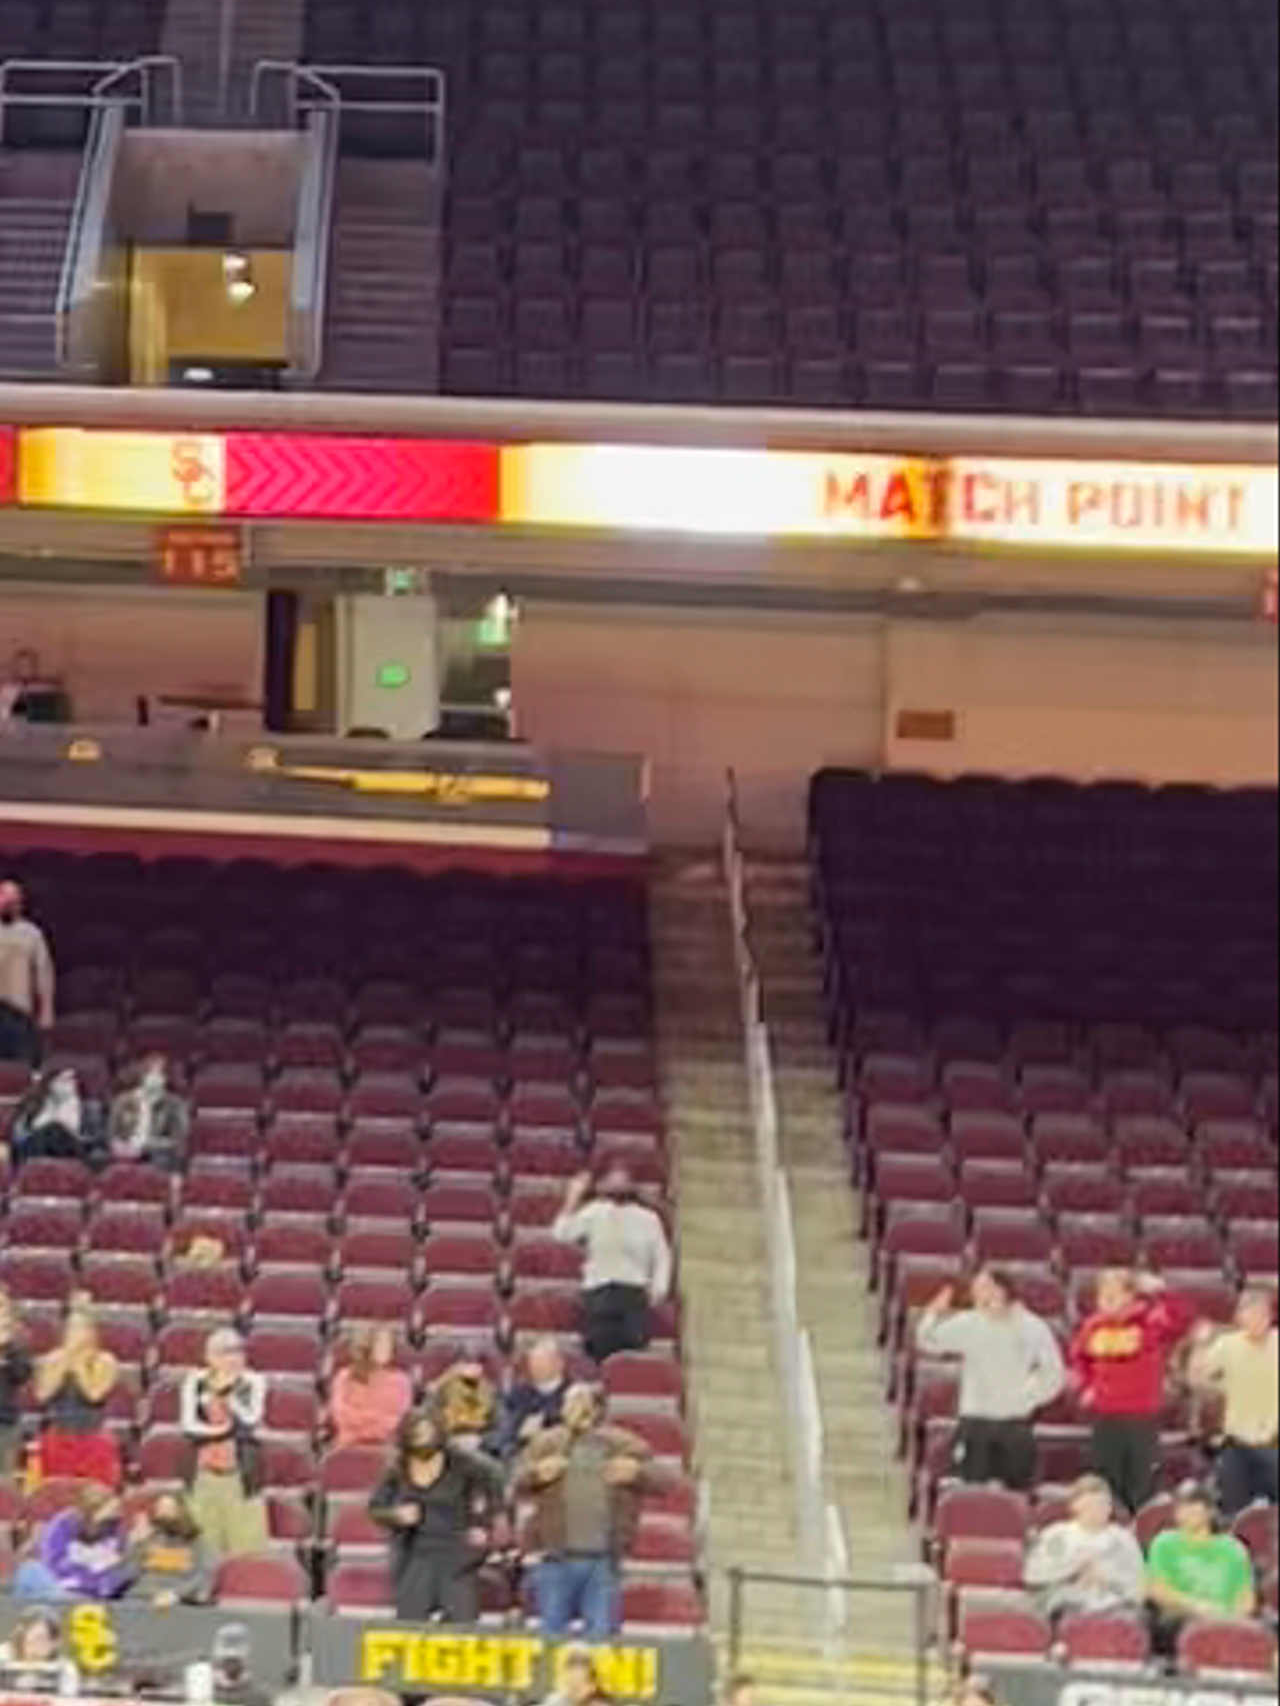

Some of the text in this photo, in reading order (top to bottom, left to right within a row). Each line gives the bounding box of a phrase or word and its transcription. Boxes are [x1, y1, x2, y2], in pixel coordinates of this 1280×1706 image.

[824, 468, 1246, 532] MATCH POINT
[361, 1628, 544, 1690] FIGHT
